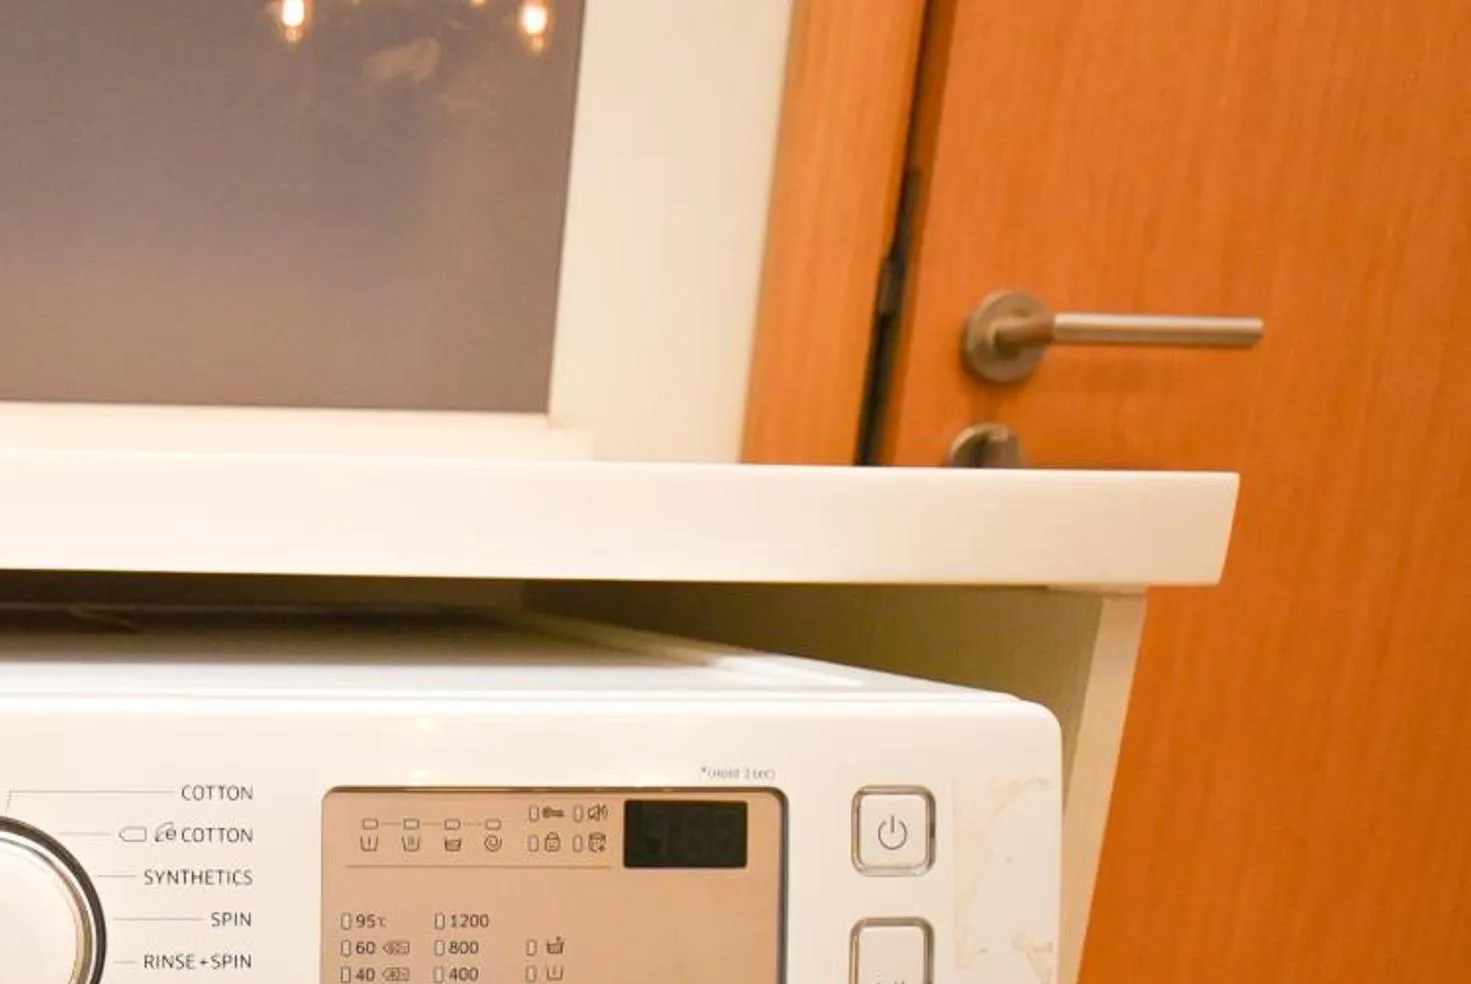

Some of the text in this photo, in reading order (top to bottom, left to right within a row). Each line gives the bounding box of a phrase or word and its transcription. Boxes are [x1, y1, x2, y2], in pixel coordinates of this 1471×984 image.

[182, 785, 252, 801] COTTON
[182, 828, 252, 842] COTTON
[144, 869, 252, 885] SYNTHETICS
[211, 912, 251, 927] SPIN
[451, 914, 489, 928] 1200
[356, 941, 376, 954] 60
[449, 941, 479, 954] 800
[356, 968, 375, 981] 40
[449, 967, 479, 981] 400
